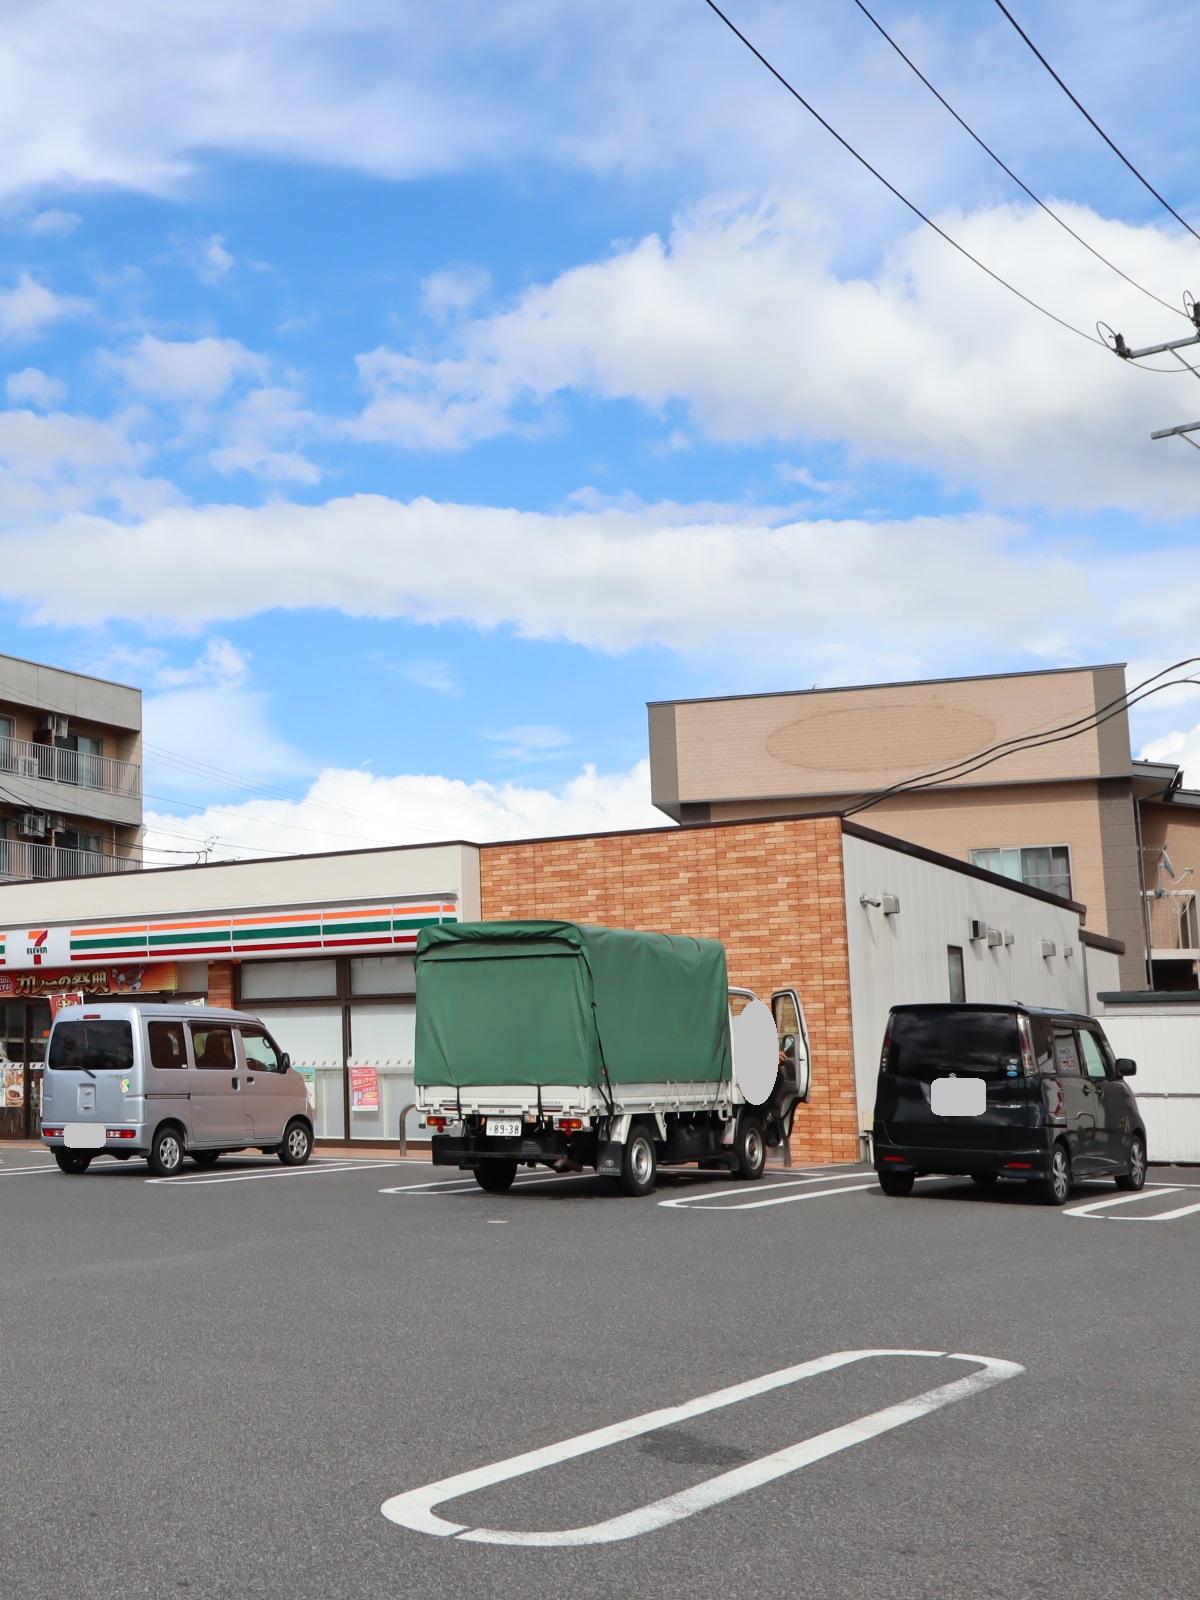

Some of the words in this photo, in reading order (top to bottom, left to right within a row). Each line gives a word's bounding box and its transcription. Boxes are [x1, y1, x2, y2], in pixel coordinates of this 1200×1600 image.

[28, 930, 48, 965] 7
[15, 968, 110, 995] カレーの祭典
[494, 1124, 519, 1135] 89-38
